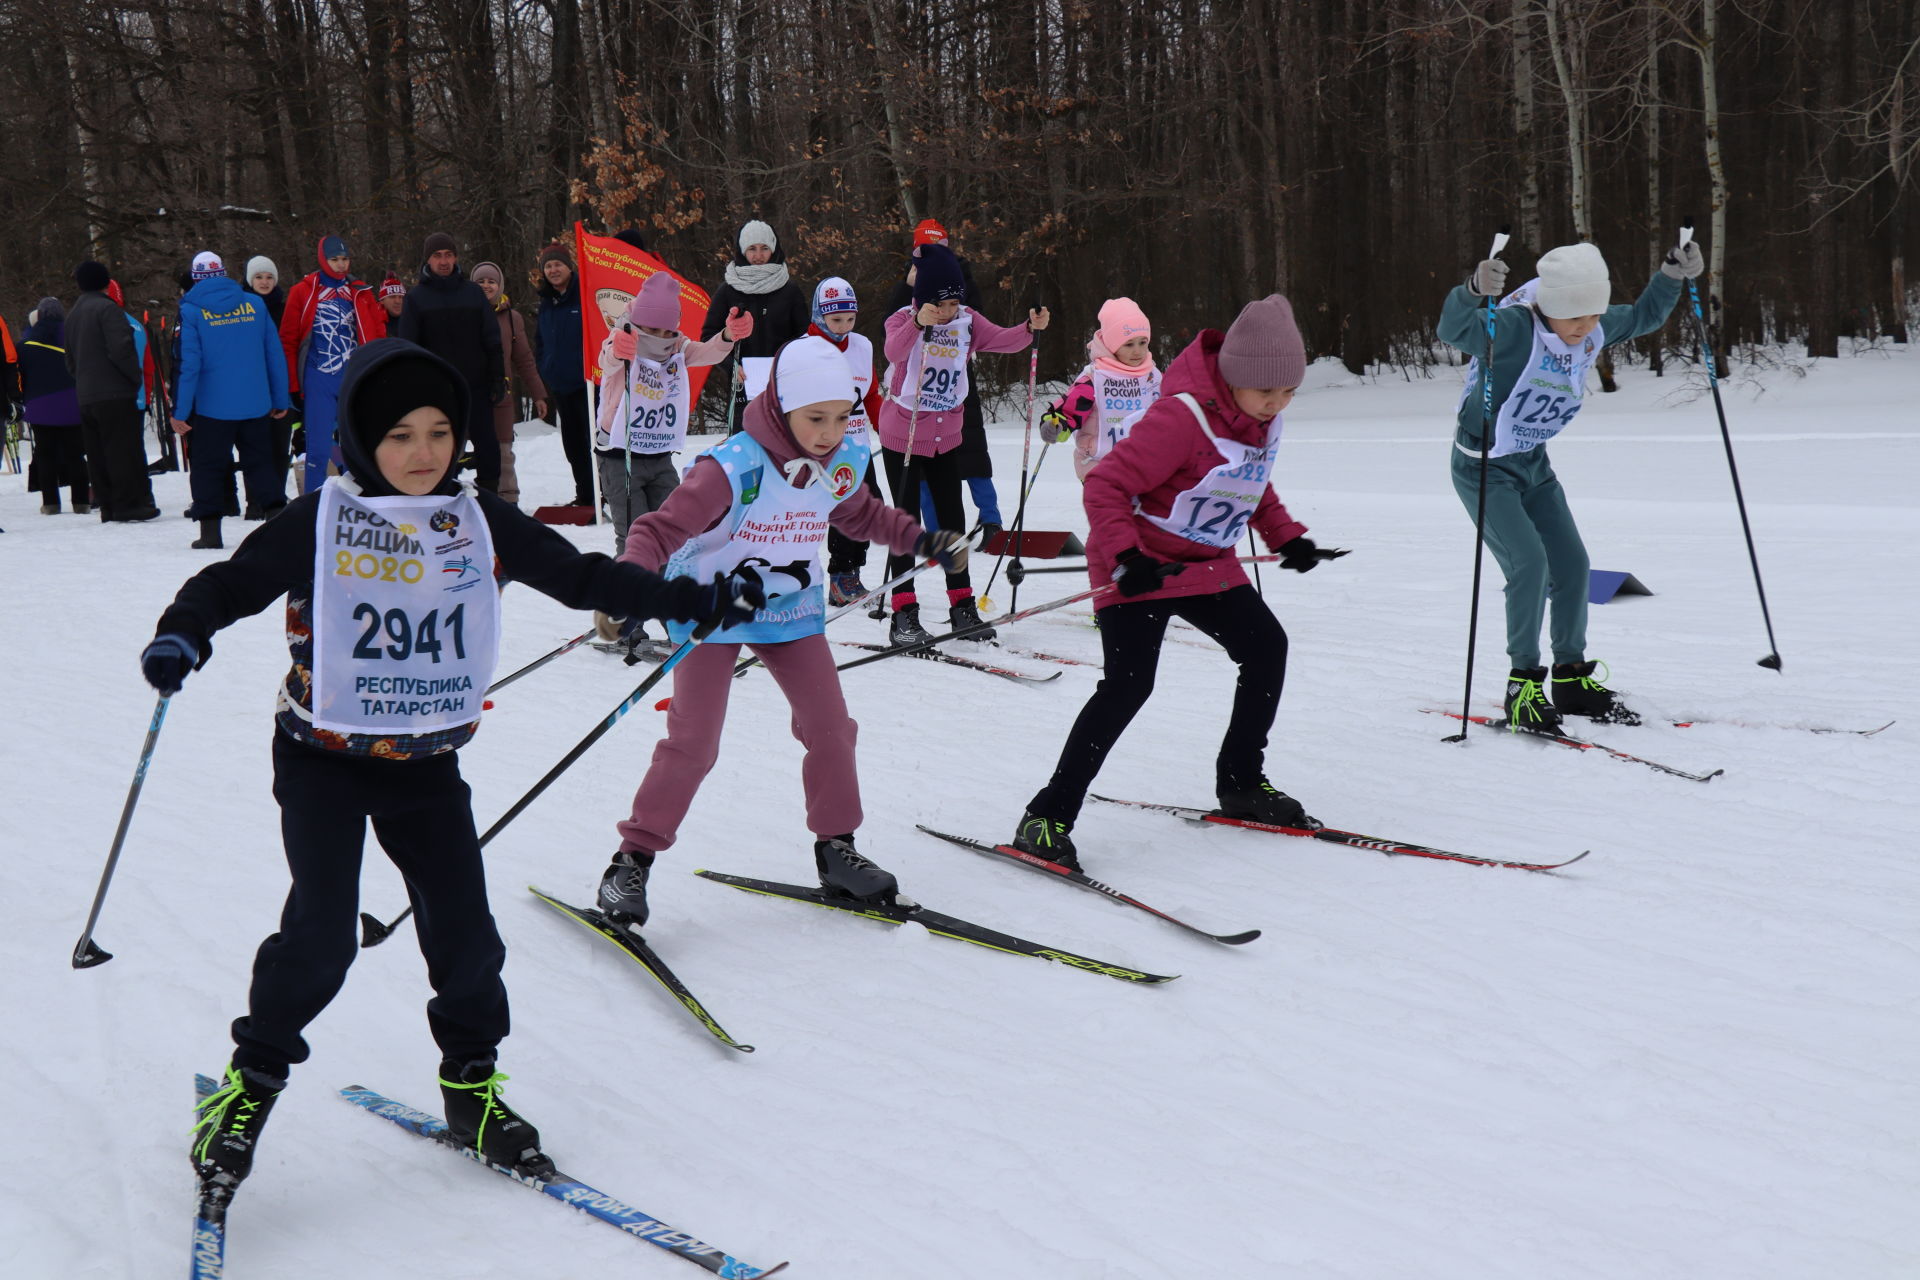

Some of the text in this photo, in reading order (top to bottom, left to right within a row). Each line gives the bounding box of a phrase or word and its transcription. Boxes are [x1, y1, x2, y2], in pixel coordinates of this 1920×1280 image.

[210, 315, 255, 327] WRESTLING TEAM
[1103, 377, 1140, 388] ЛЫЖНЯ
[1104, 387, 1141, 398] РОССИИ
[1105, 398, 1142, 411] 2022
[1512, 388, 1582, 426] 1254
[335, 525, 425, 556] НАЦИИ
[335, 550, 425, 584] 2020
[352, 602, 466, 664] 2941
[355, 675, 473, 696] РЕСПУБЛИКА
[361, 697, 465, 716] ТАТАРСТАН
[1032, 949, 1147, 981] FISCHER
[563, 1186, 633, 1217] SPORT
[620, 1220, 716, 1256] ATEMI
[192, 1229, 223, 1280] SPOR
